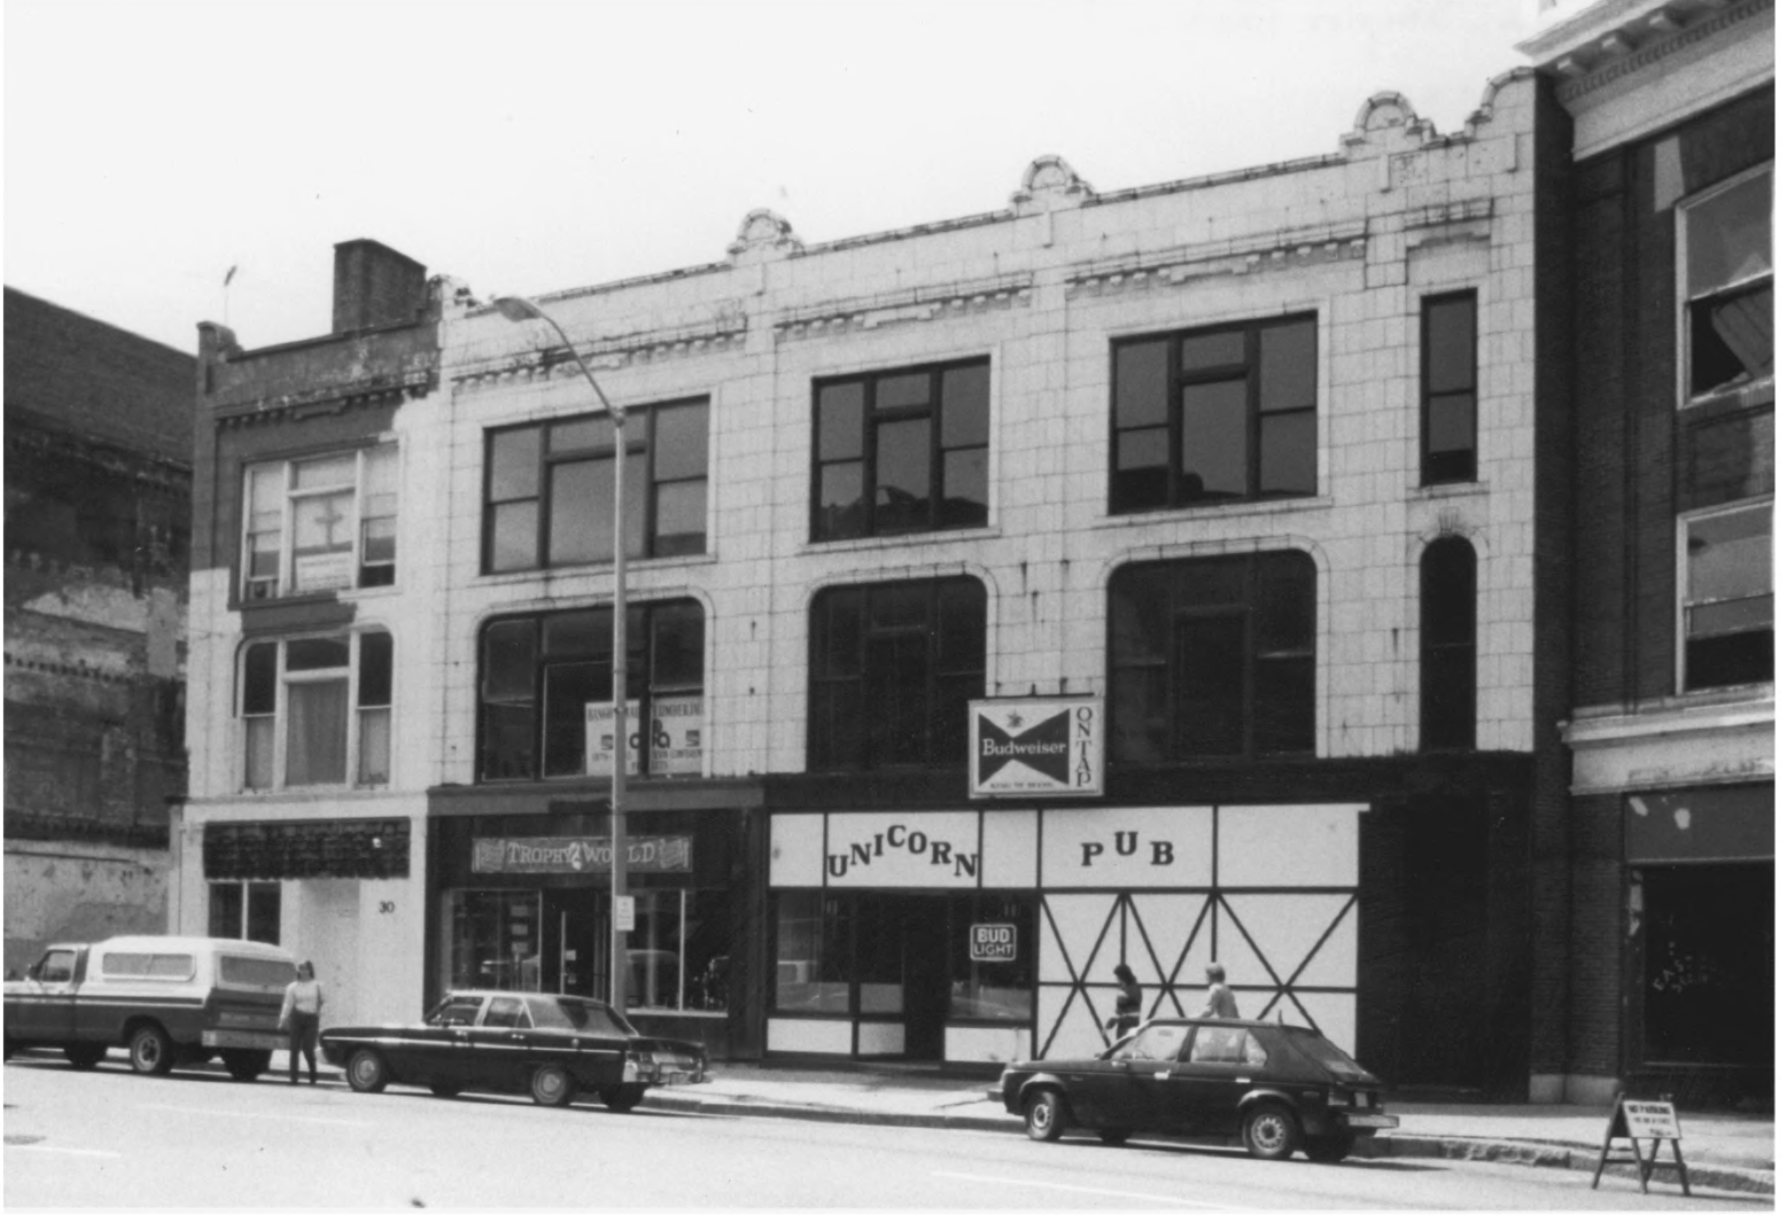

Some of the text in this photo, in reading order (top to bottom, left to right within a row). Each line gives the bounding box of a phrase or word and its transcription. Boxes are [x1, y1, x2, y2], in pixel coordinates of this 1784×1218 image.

[982, 738, 1067, 756] Budweiser
[507, 841, 656, 864] TROPHY WOLD
[828, 825, 978, 878] UNICORN
[1080, 830, 1175, 867] PUB
[379, 900, 396, 915] 30
[977, 928, 1011, 943] BUD
[974, 943, 1012, 956] LIGHT
